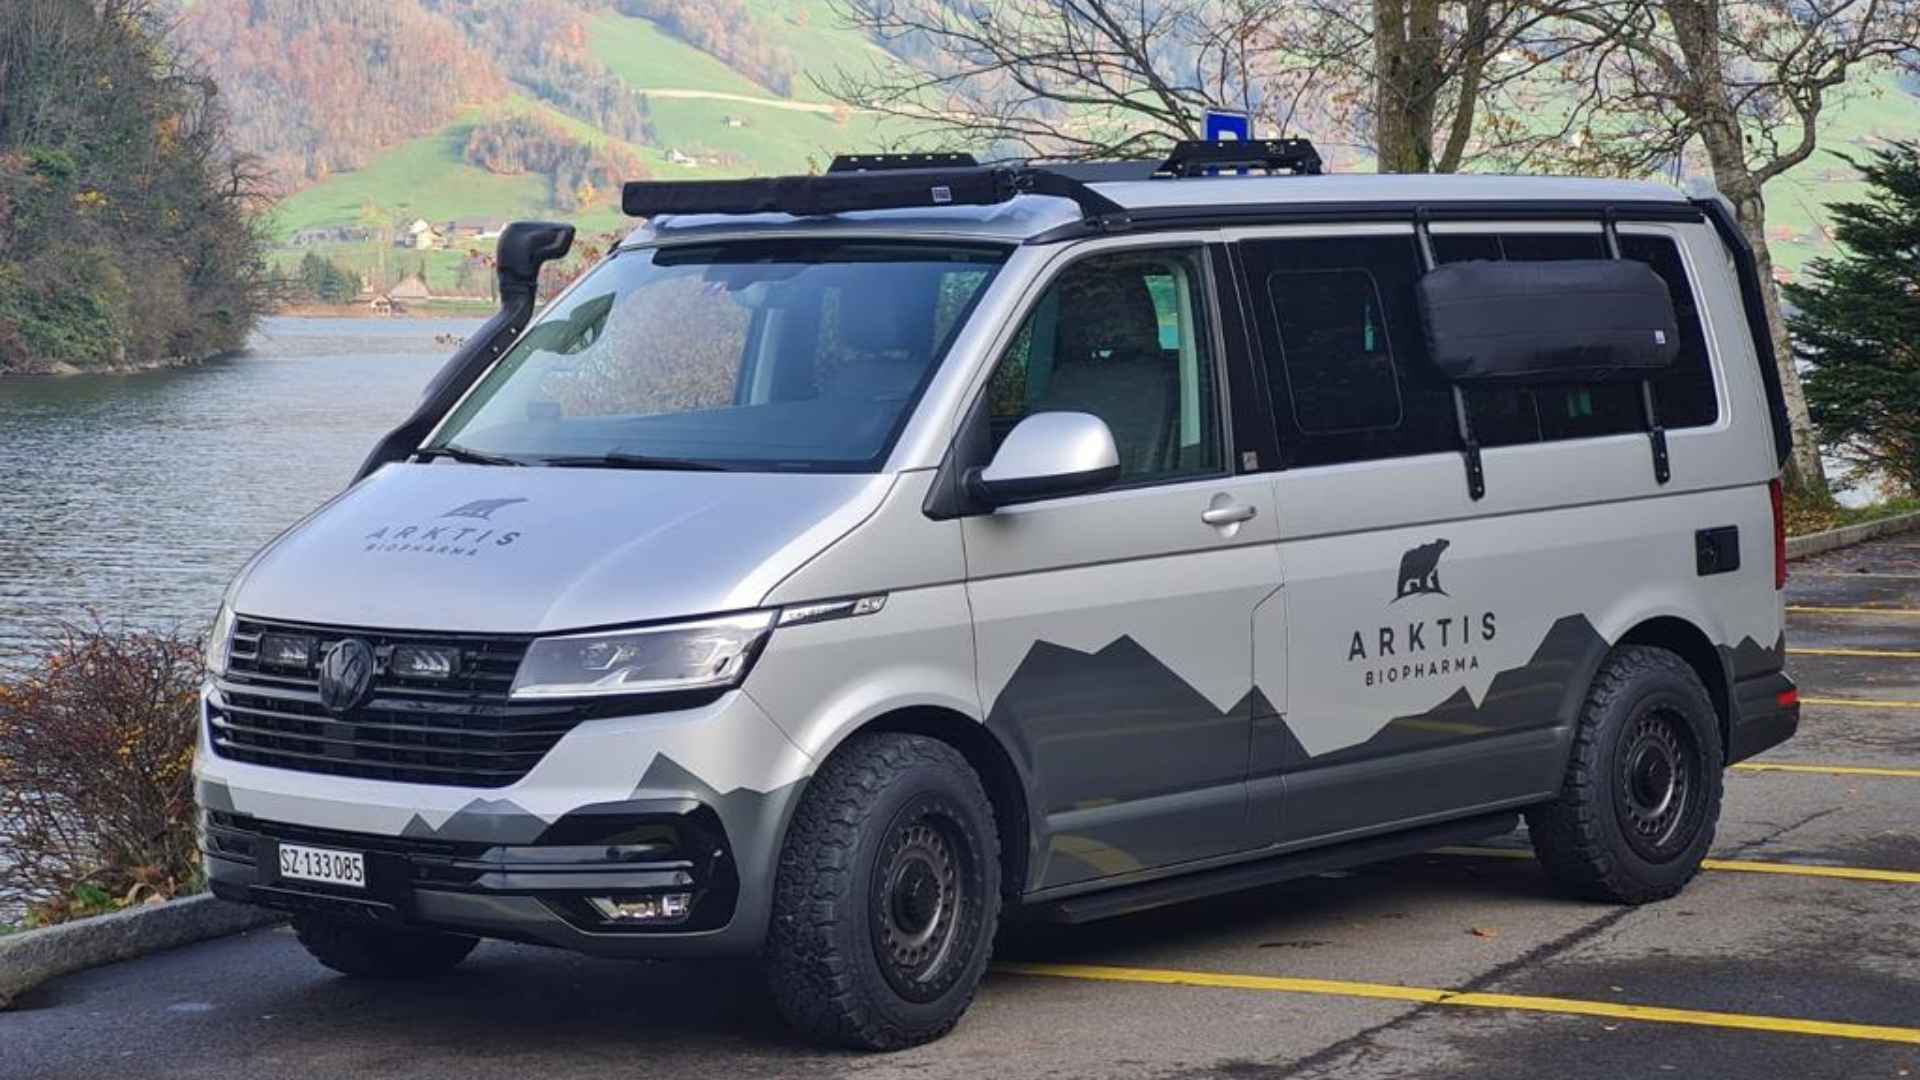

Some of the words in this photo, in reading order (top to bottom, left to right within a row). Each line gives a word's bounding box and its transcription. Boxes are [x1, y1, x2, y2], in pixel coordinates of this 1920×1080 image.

[365, 526, 521, 545] ARKTIS
[1348, 611, 1496, 662] ARKTIS
[1365, 655, 1479, 686] BIOPHARMA
